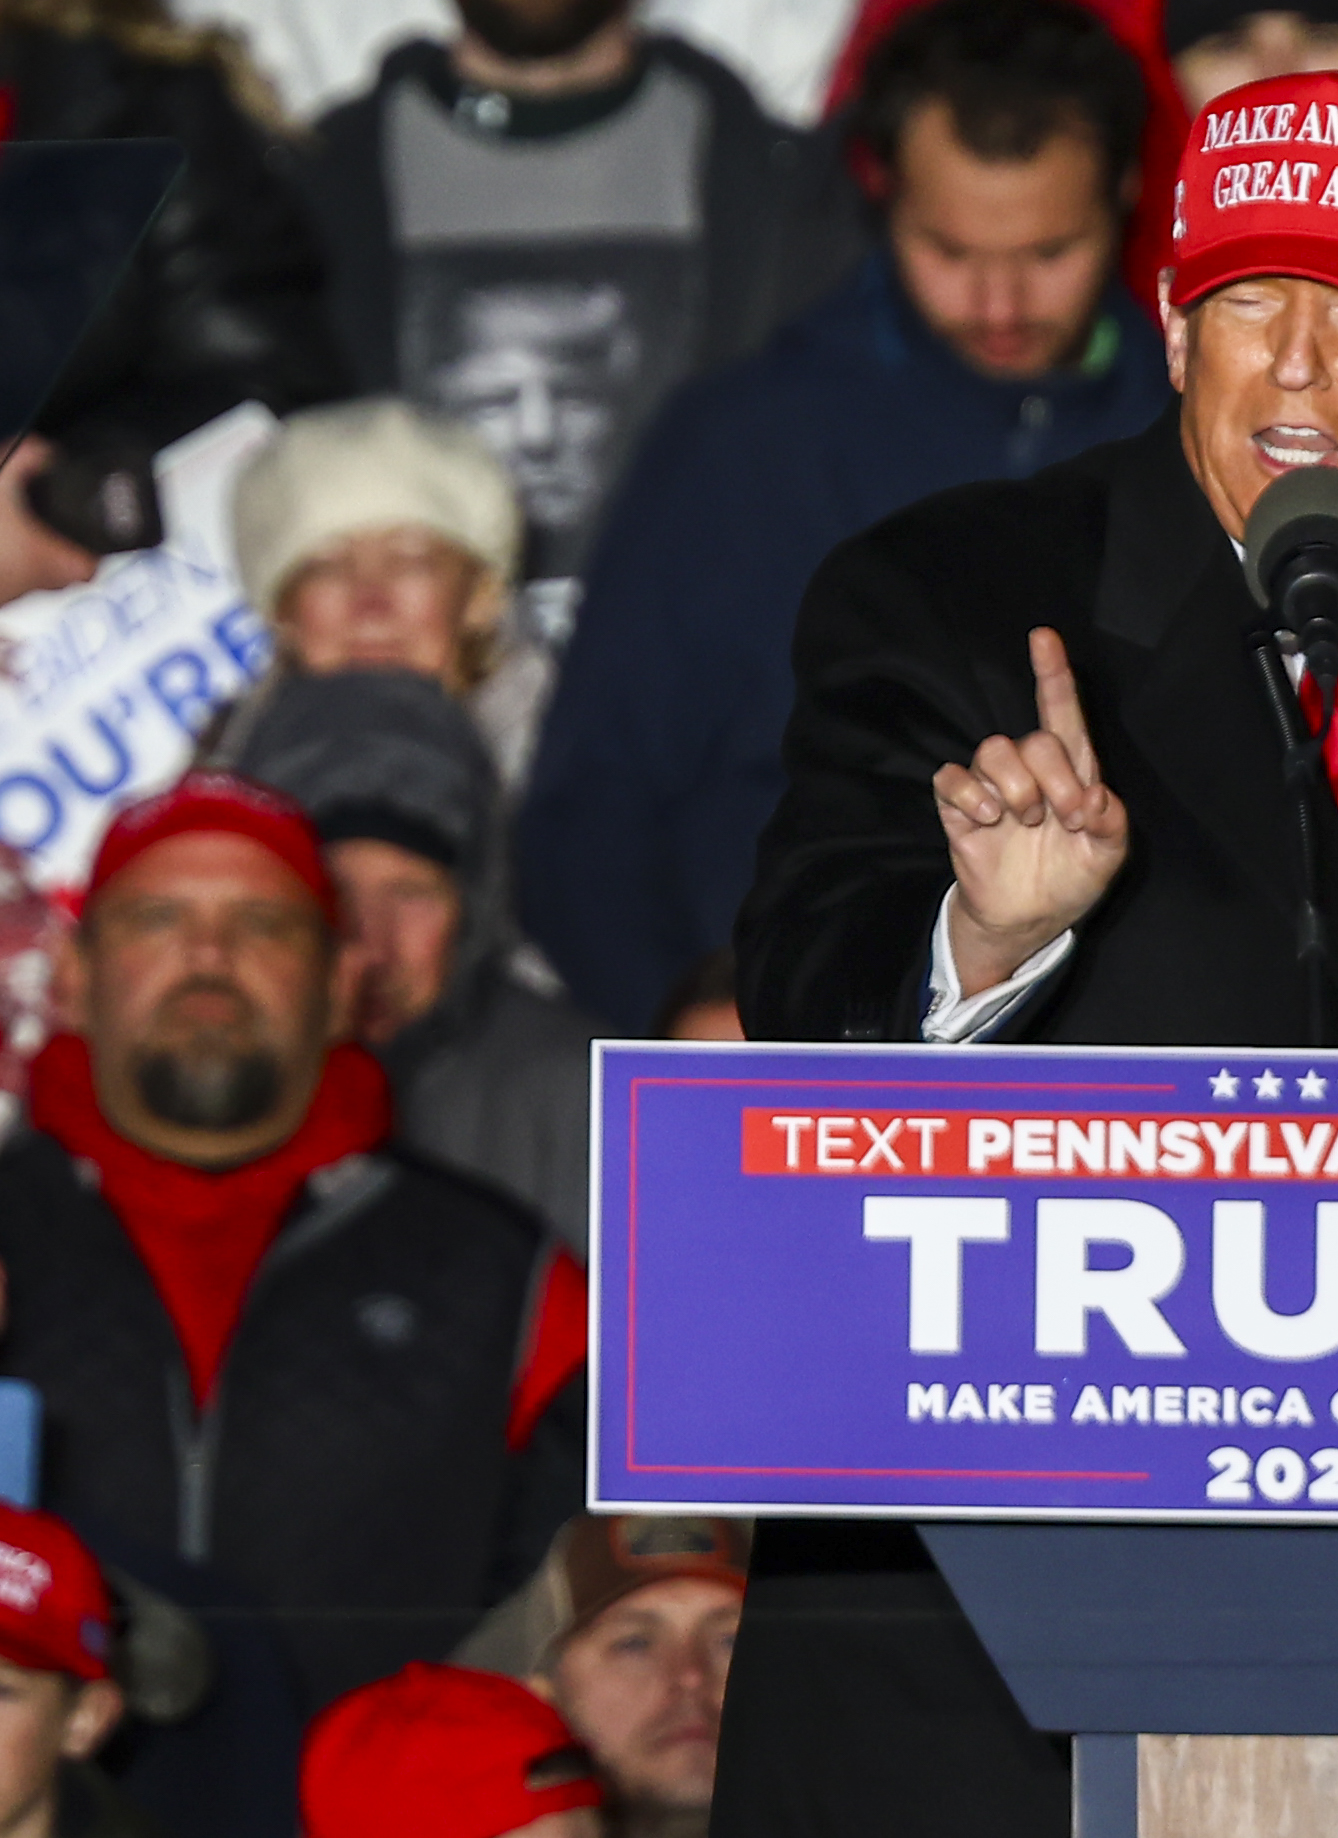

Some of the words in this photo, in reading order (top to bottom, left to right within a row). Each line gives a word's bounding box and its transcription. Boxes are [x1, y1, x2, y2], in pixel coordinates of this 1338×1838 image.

[1200, 102, 1297, 154] MAKE
[1212, 160, 1320, 210] GREAT
[770, 1115, 949, 1172] TEXT
[906, 1382, 1057, 1424] MAKE
[1071, 1385, 1315, 1427] AMERICA
